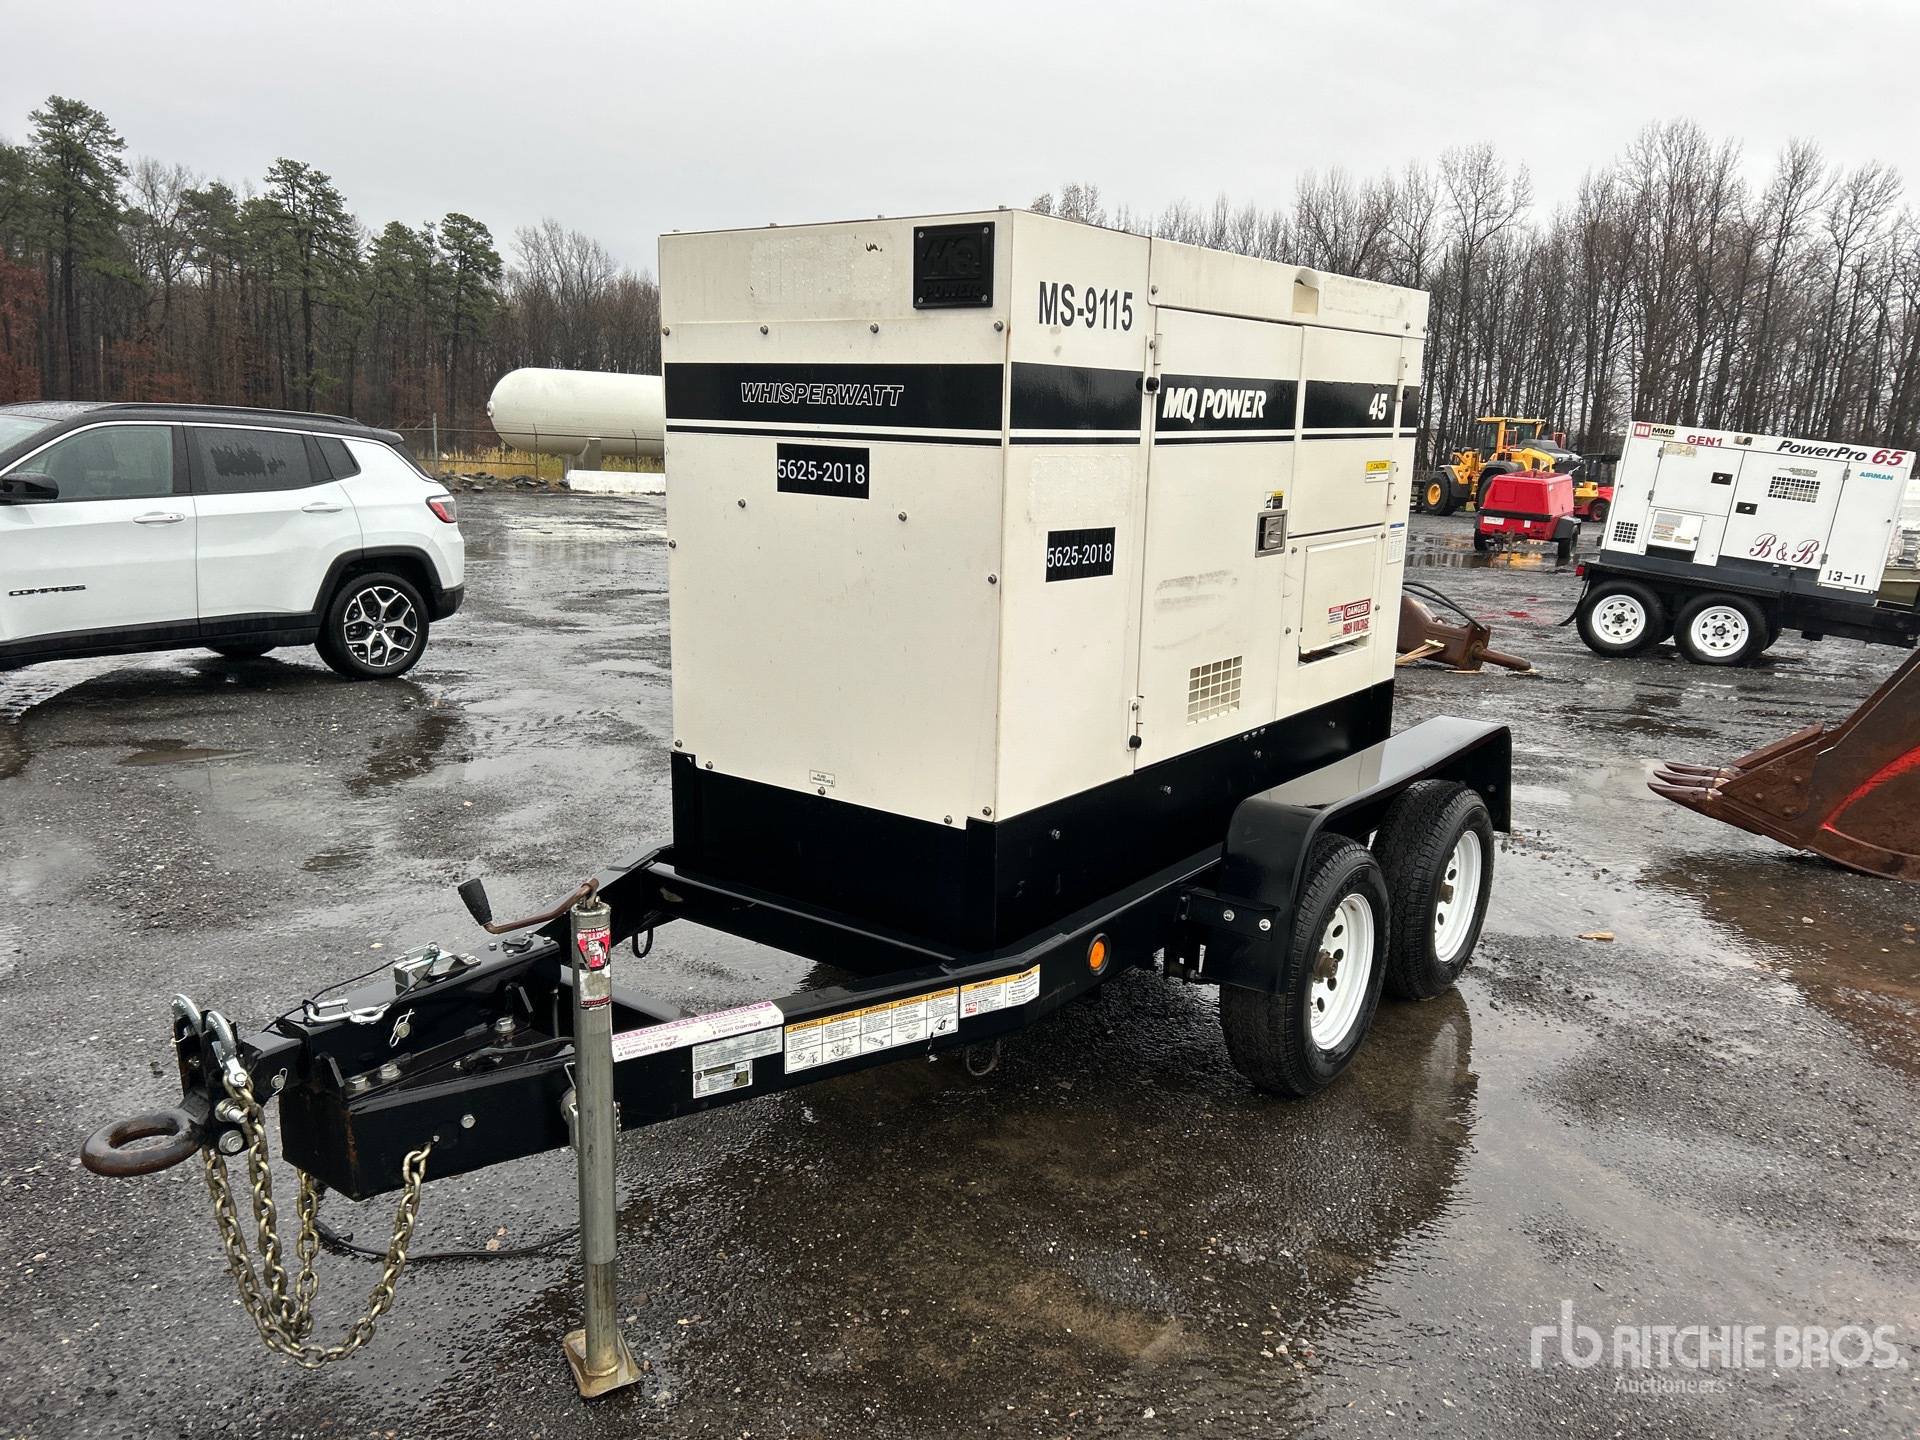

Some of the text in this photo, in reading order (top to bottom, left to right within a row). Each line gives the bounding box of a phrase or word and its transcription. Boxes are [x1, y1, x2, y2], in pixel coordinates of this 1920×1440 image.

[923, 283, 981, 299] POWER
[1038, 281, 1133, 332] MS-9115
[740, 382, 905, 407] WHISPERWATT
[1162, 387, 1267, 424] MQ POWER
[1368, 393, 1388, 420] 45
[1651, 427, 1676, 436] MMD
[1686, 435, 1724, 447] GEN1
[1776, 440, 1908, 467] PowerPro 65
[777, 458, 866, 485] 5625-2018
[1860, 471, 1894, 481] AIRMAN
[1047, 542, 1112, 568] 5625-2018
[1749, 533, 1820, 565] B & B
[1827, 570, 1866, 586] 13-11
[8, 585, 87, 597] COMPASS
[1346, 603, 1368, 617] DANGER
[1353, 618, 1369, 632] VOLTAGE
[718, 1026, 734, 1034] Paint
[624, 1045, 653, 1056] Manuals
